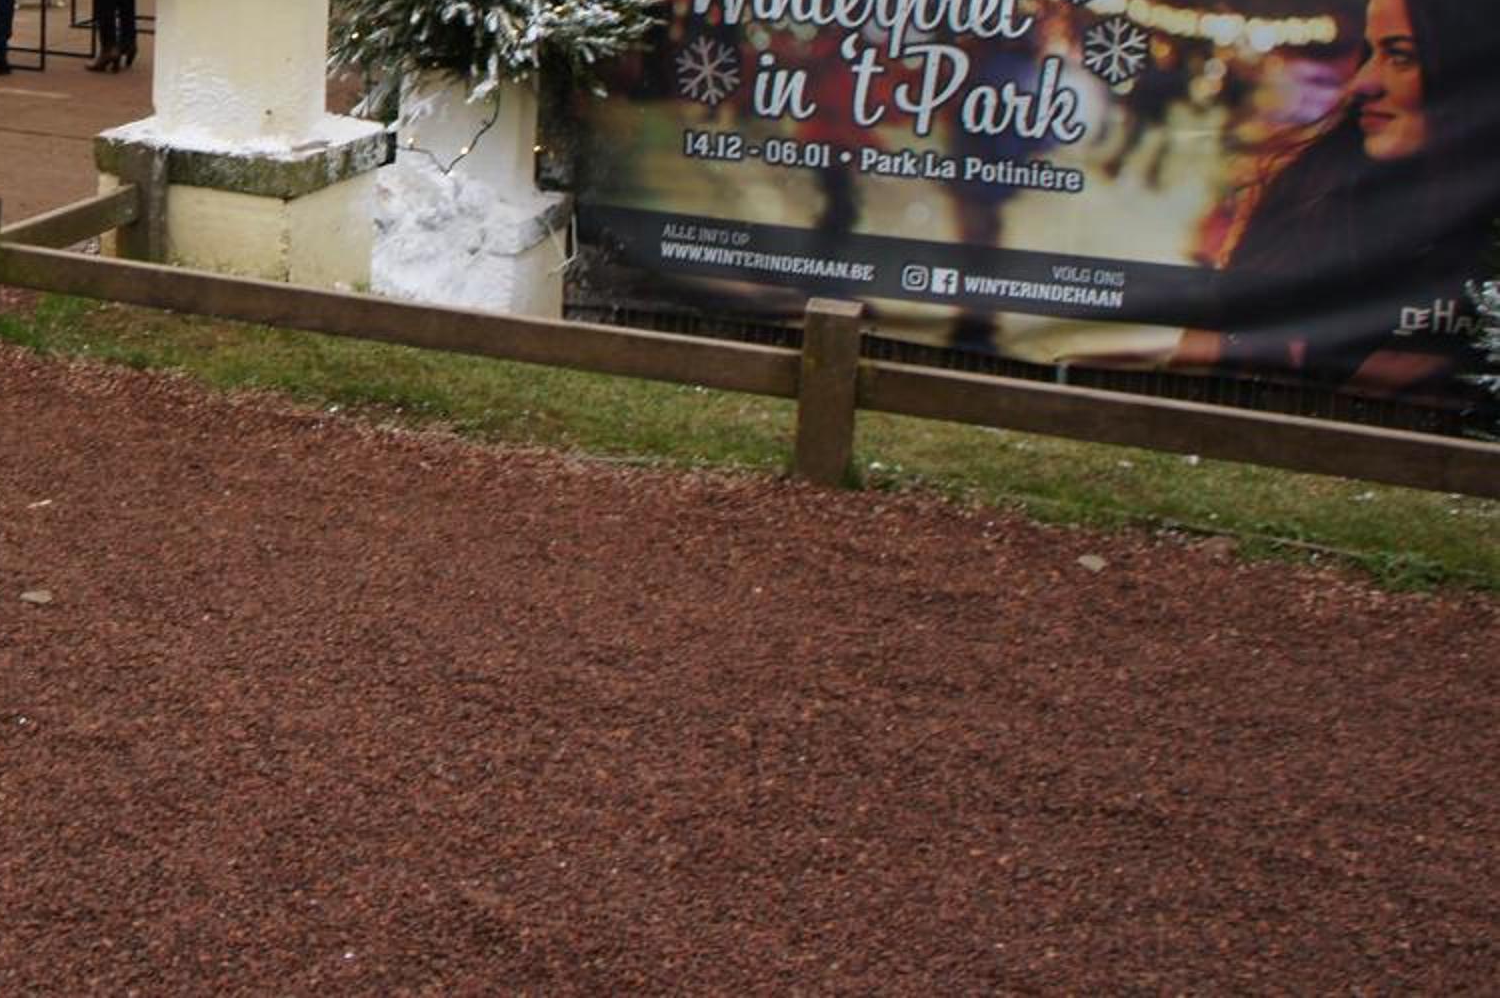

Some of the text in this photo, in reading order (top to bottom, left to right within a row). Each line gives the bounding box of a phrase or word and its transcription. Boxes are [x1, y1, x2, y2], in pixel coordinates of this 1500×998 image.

[753, 53, 817, 120] in
[894, 44, 1088, 142] Park
[685, 131, 743, 159] 14.12
[765, 139, 830, 168] 06.01
[860, 148, 919, 176] Park
[923, 153, 956, 179] La
[963, 157, 1083, 191] Potinière
[661, 224, 696, 241] ALLE
[731, 232, 750, 246] OP
[660, 241, 875, 281] WWW.WINTERINDEHAAN.BE
[1052, 265, 1125, 287] VOLG ONS
[964, 275, 1125, 308] WINTERINDEHAAN
